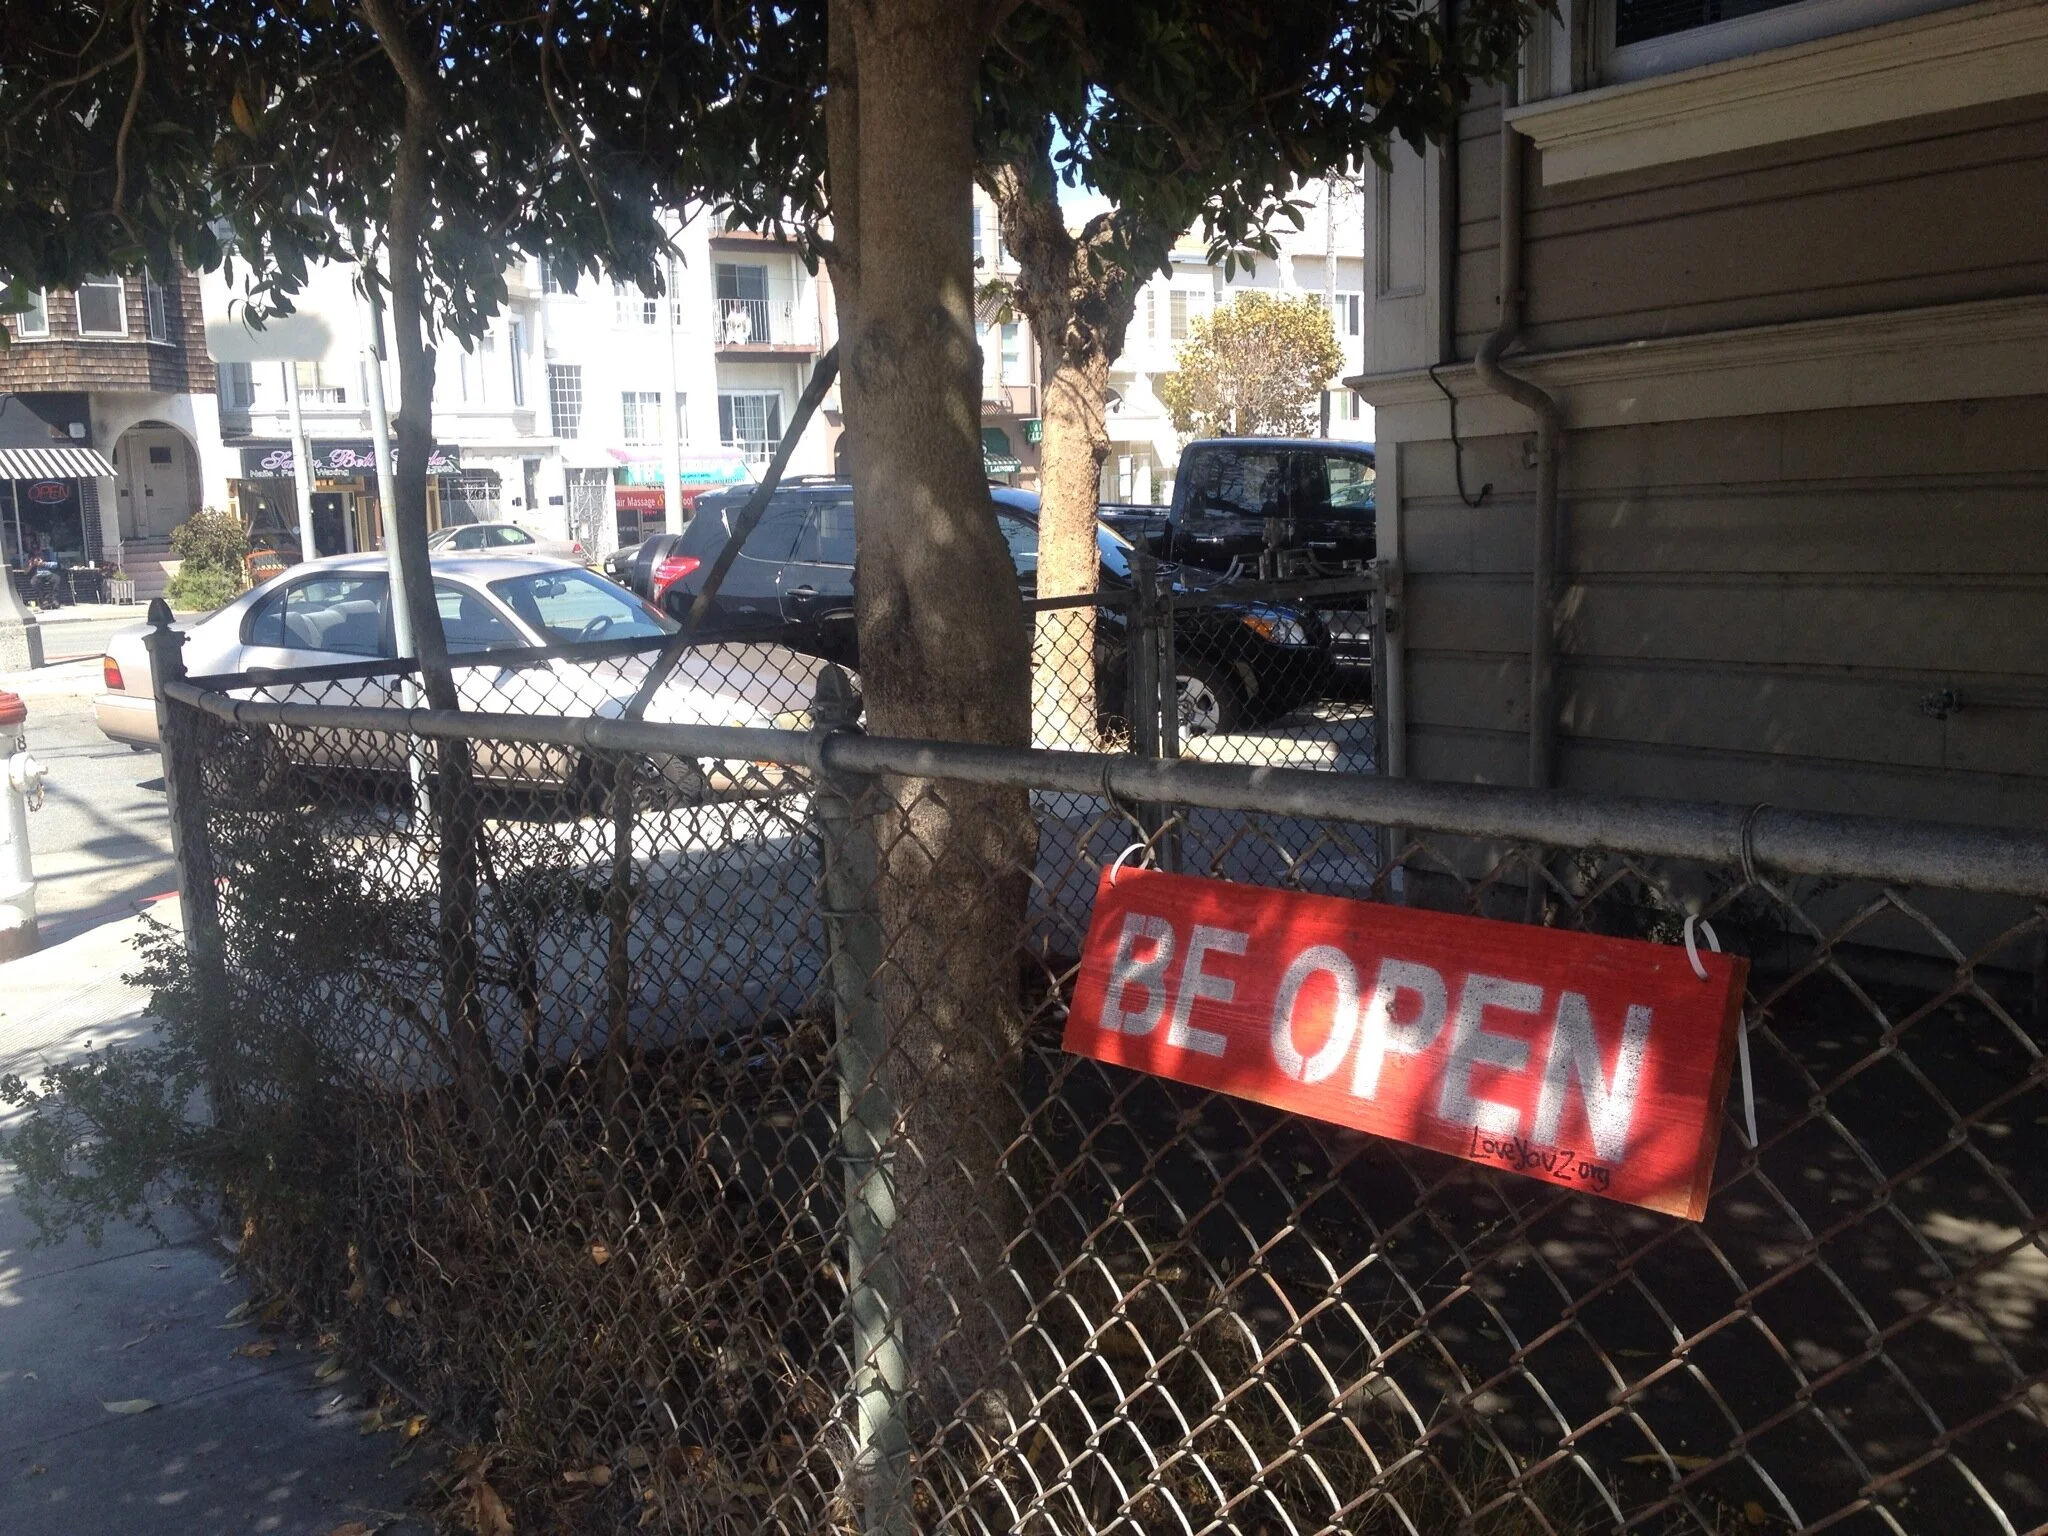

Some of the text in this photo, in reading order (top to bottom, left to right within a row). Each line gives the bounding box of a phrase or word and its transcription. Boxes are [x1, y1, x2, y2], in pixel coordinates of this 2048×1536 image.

[28, 484, 69, 500] OPEN
[627, 496, 656, 509] Massage
[681, 496, 694, 506] oot
[1099, 911, 1654, 1164] BE OPEN
